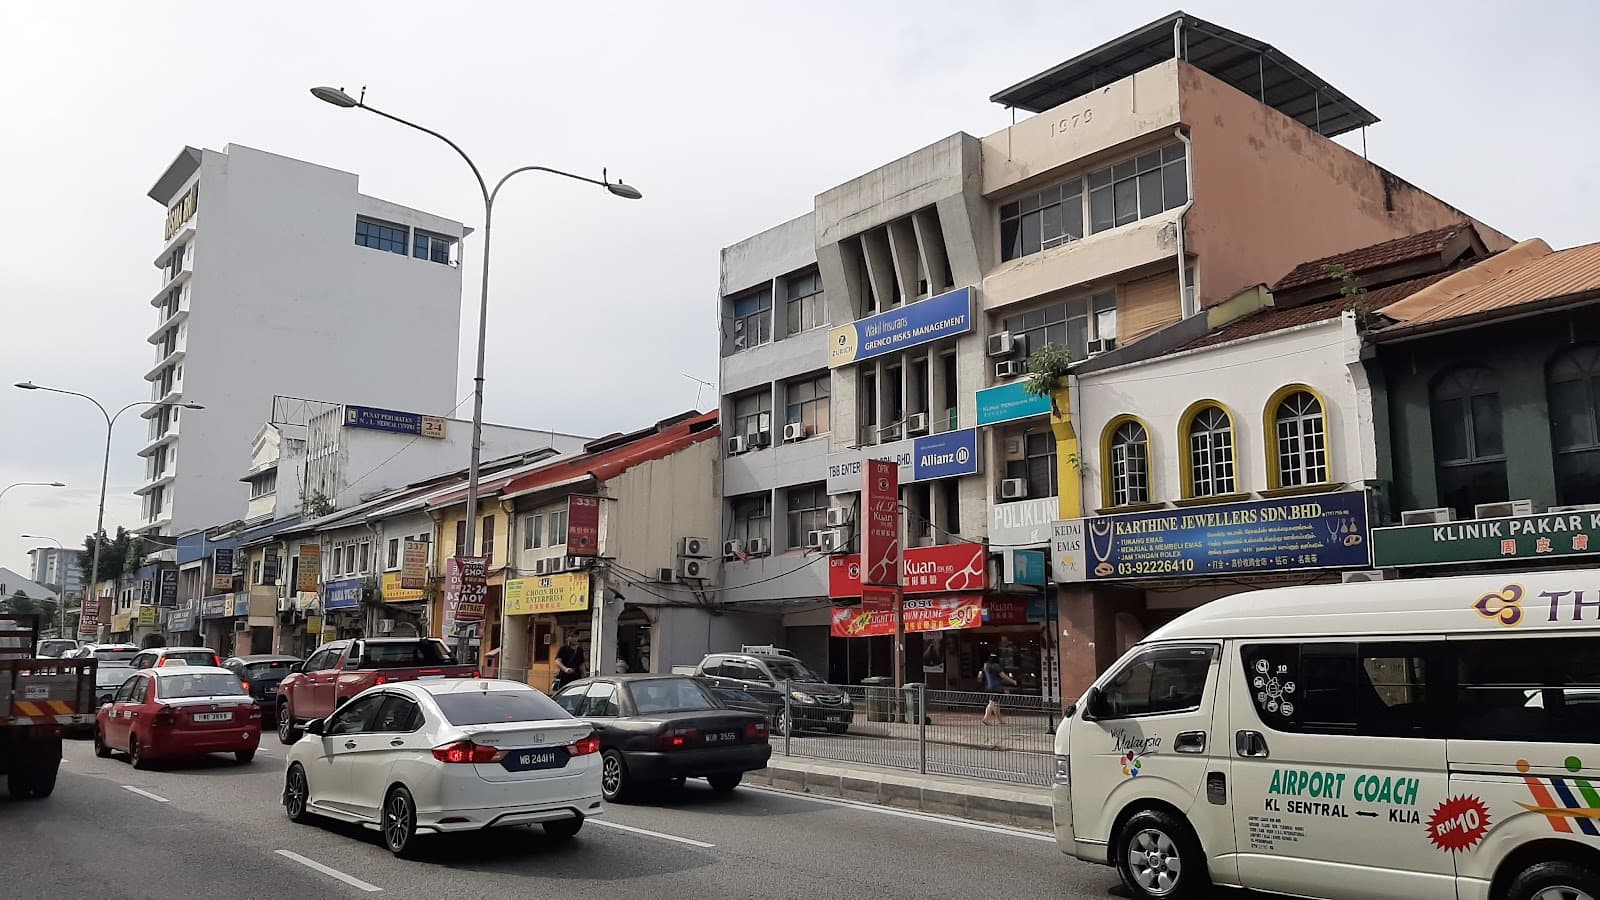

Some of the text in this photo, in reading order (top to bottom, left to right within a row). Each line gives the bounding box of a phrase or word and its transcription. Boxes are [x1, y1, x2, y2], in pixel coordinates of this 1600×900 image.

[1051, 109, 1093, 137] 1979
[864, 317, 908, 337] Wakil Insurans
[864, 315, 965, 350] GRENCO RISKS MANAGEMENT
[832, 345, 853, 357] ZURICH
[426, 423, 442, 431] 24
[920, 453, 954, 468] Allianz
[829, 465, 840, 477] TBB
[841, 461, 861, 475] ENTER
[873, 511, 893, 522] Kuan
[1116, 517, 1178, 535] KARTHINE
[1180, 508, 1257, 530] JEWELLERS
[1054, 525, 1081, 537] KEDAI
[1433, 522, 1502, 542] KLINIK
[1509, 516, 1583, 536] PAKAR
[1057, 541, 1080, 552] EMAS
[1120, 537, 1145, 546] TUKANG
[1154, 543, 1184, 551] MEMBELI
[1184, 541, 1202, 549] EMAS
[1120, 553, 1134, 561] JAM
[903, 559, 936, 575] Kuan
[1118, 559, 1194, 575] 03-92226410
[461, 594, 484, 602] NOV
[526, 594, 564, 603] ENTERPRISE
[871, 614, 889, 625] LIGHT
[919, 609, 942, 619] FRAME
[1278, 664, 1288, 672] 10
[1112, 733, 1162, 756] Malaysia
[519, 754, 530, 765] WB
[1268, 767, 1420, 807] AIRPORT COACH
[1265, 798, 1421, 825] KL SENTRAL KLIA
[1436, 808, 1480, 837] RM10
